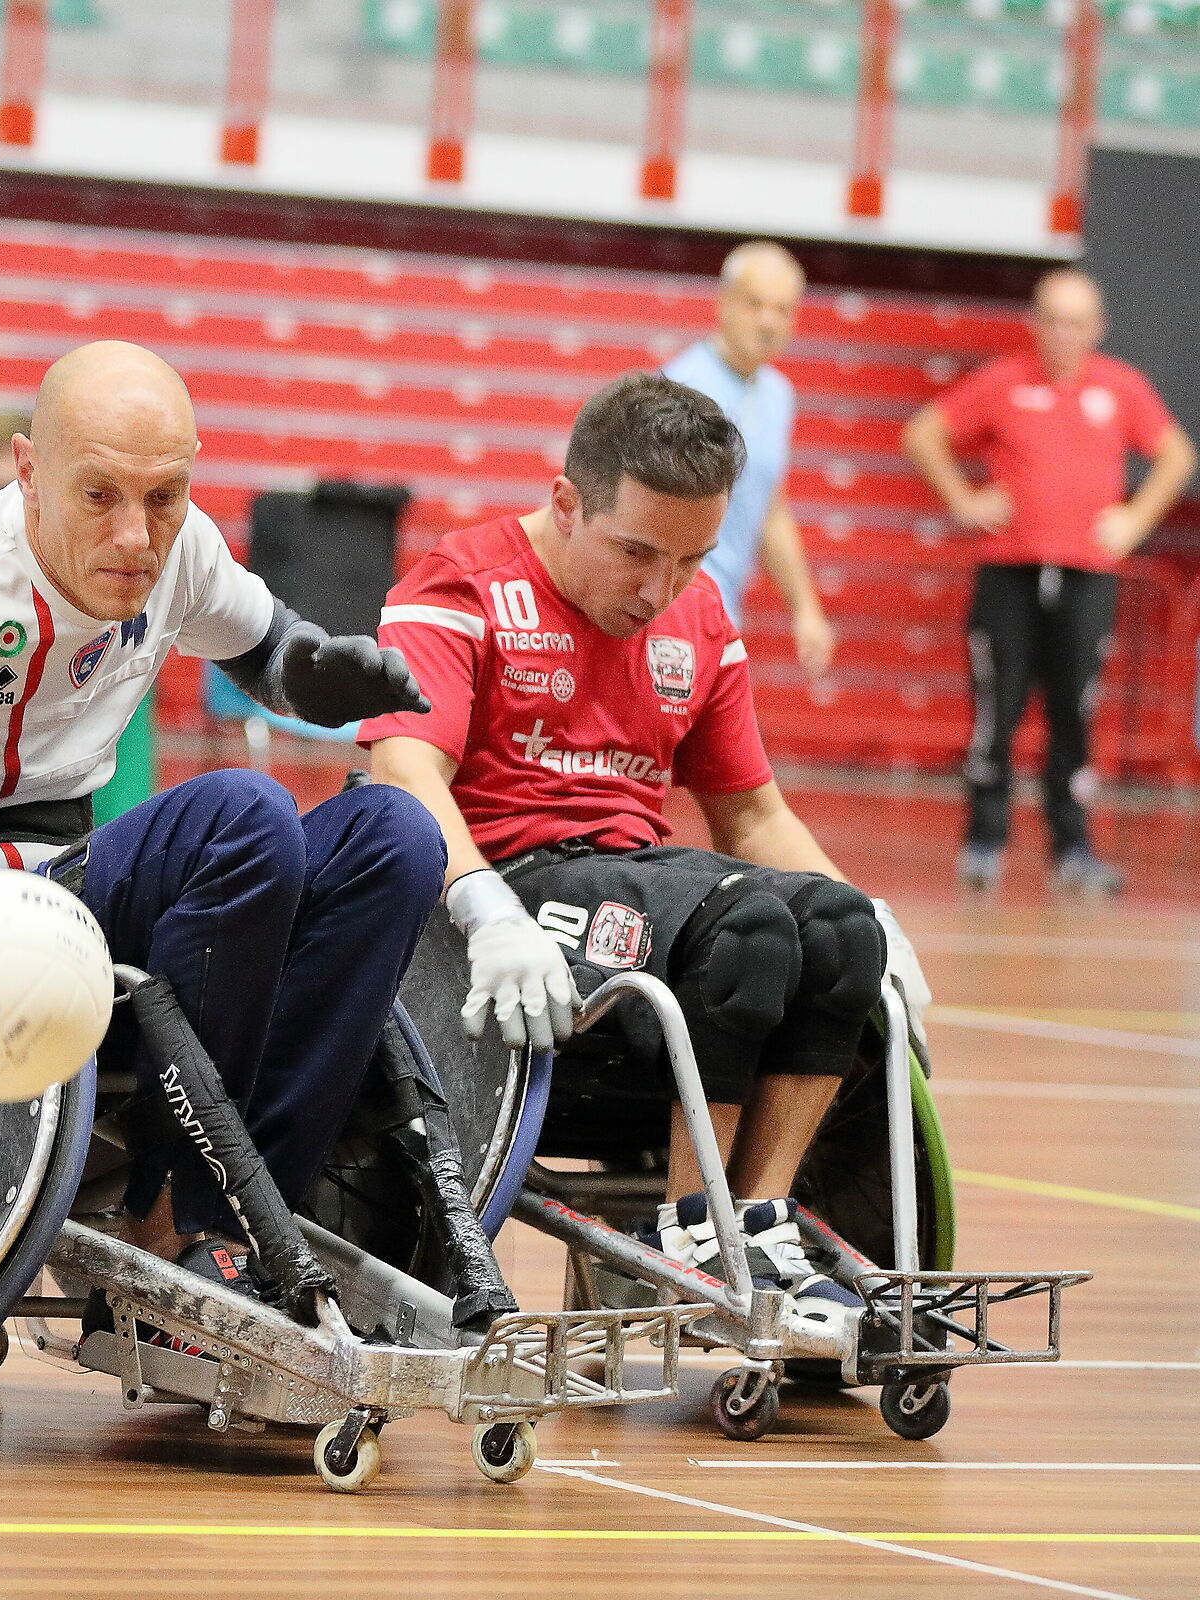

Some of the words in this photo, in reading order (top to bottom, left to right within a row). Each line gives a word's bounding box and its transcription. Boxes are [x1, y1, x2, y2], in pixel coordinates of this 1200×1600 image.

[489, 579, 540, 630] 10
[495, 630, 575, 652] macron
[502, 664, 550, 687] Rotary
